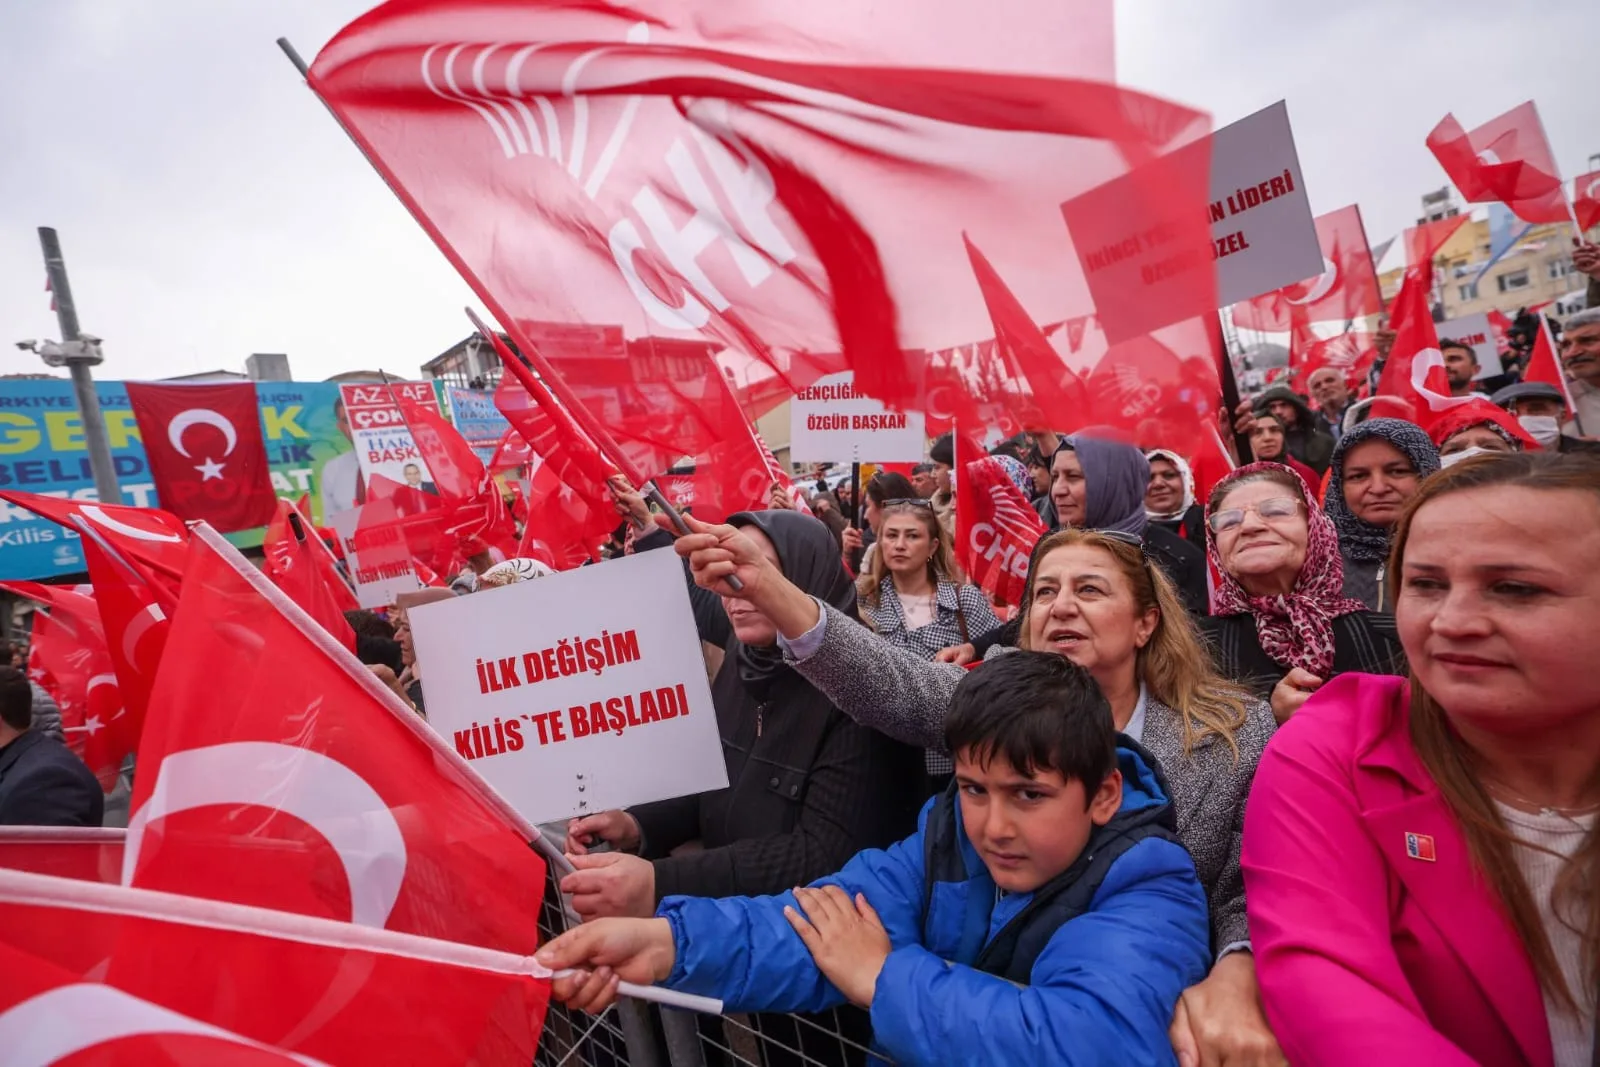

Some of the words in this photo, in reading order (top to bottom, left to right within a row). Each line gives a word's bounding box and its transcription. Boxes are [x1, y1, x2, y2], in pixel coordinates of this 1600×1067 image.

[1226, 168, 1295, 216] LİDERİ
[352, 386, 385, 404] AZ
[807, 413, 849, 431] ÖZGÜR
[852, 414, 907, 432] BAŞKAN
[368, 437, 415, 450] HAK
[368, 446, 421, 463] BAŞK
[969, 521, 1030, 579] CHP
[476, 658, 521, 694] İLK
[522, 630, 641, 684] DEĞİŞİM
[569, 683, 690, 738] BAŞLADI
